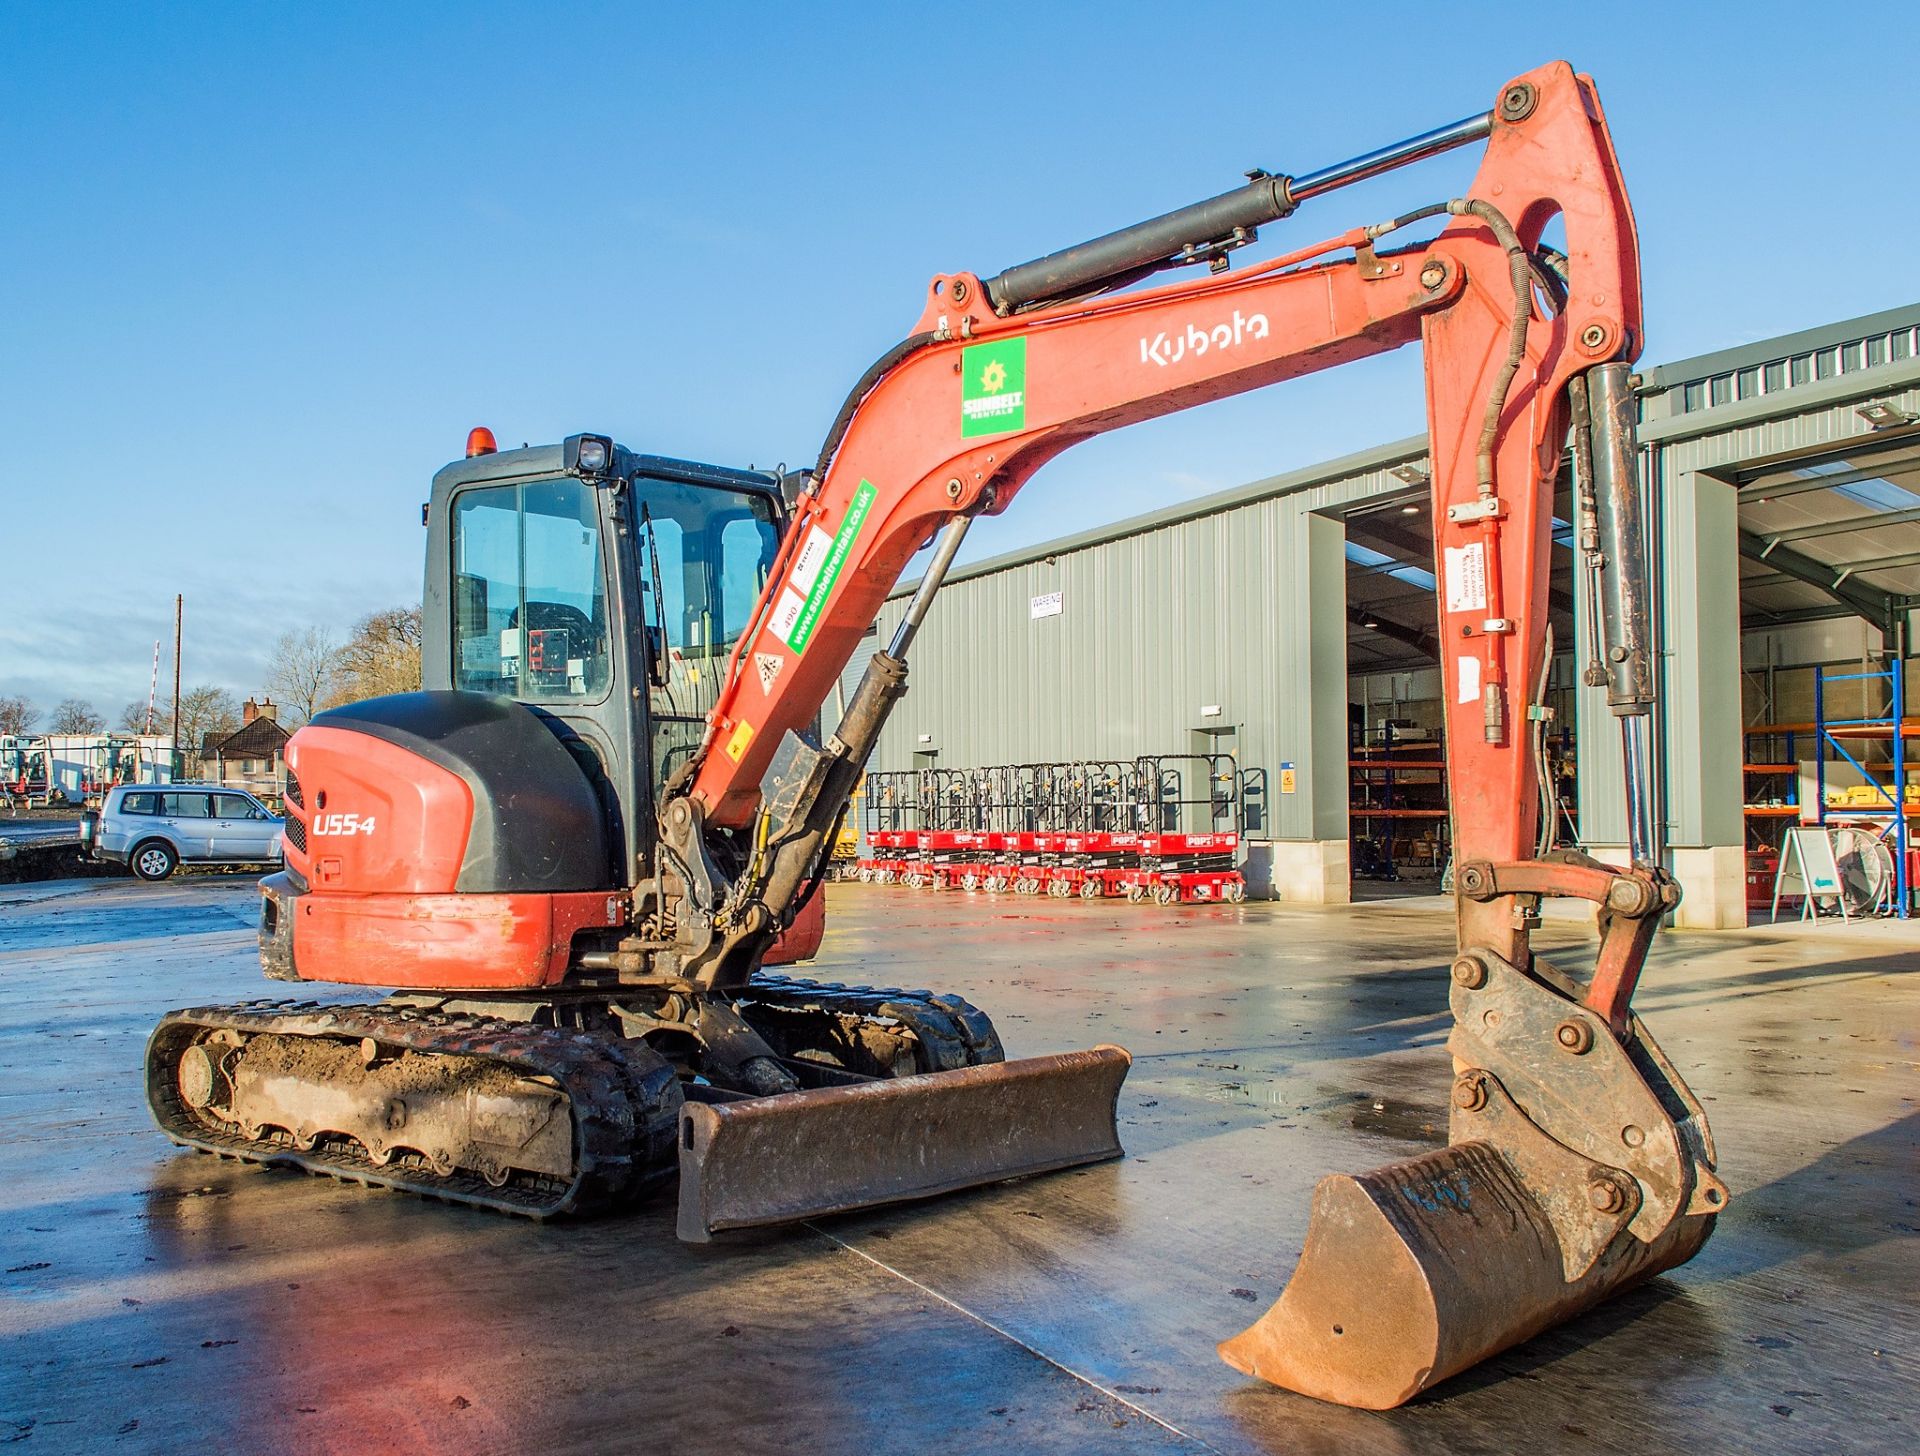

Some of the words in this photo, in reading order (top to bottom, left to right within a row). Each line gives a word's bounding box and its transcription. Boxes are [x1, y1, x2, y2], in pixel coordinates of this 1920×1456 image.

[1139, 309, 1270, 367] Kubota
[794, 490, 871, 645] www.sunbeltrentals.co.uk
[1470, 565, 1478, 608] EXCAVATOR
[312, 813, 376, 836] U55-4
